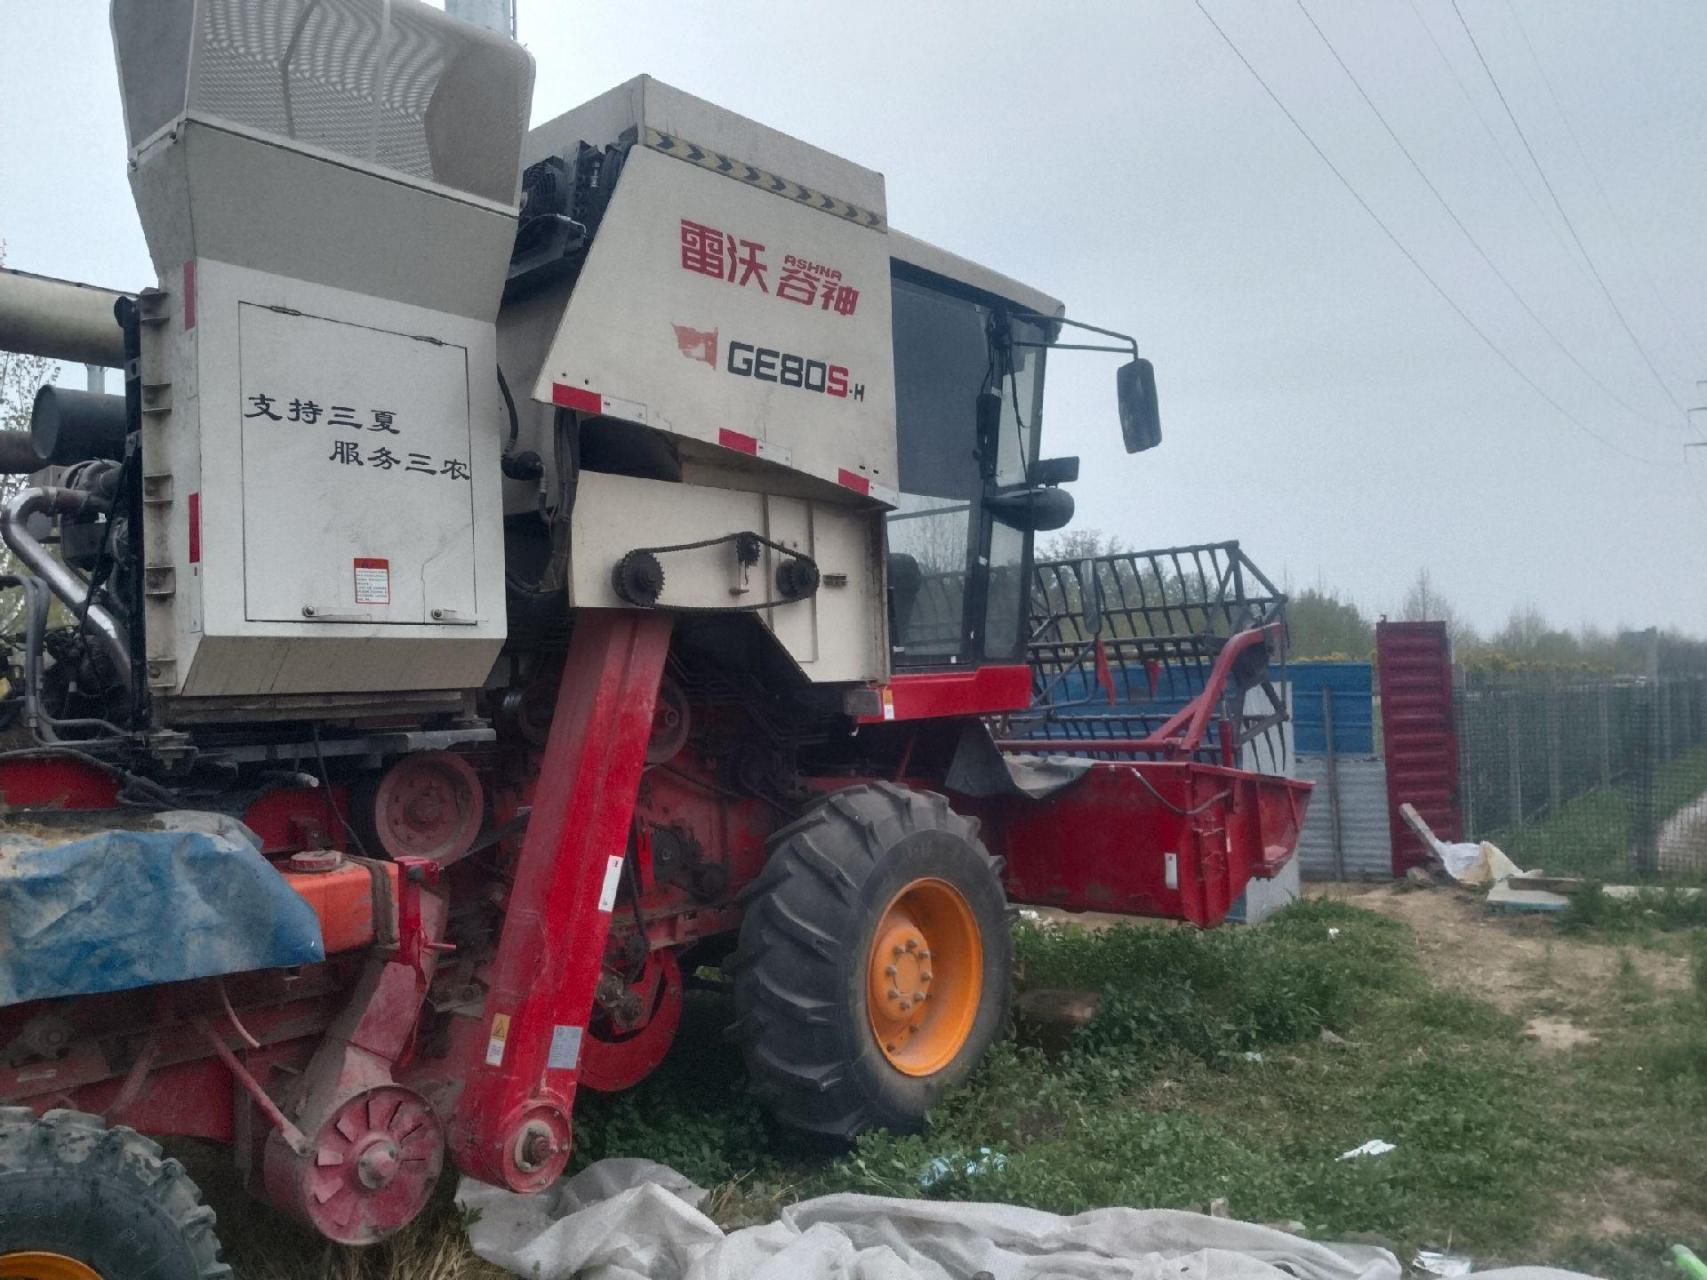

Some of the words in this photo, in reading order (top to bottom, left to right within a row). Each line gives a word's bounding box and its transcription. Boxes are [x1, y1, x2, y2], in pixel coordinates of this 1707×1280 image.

[784, 254, 842, 281] ASHNA
[244, 393, 401, 435] 支持三夏
[328, 440, 471, 481] 服务三农
